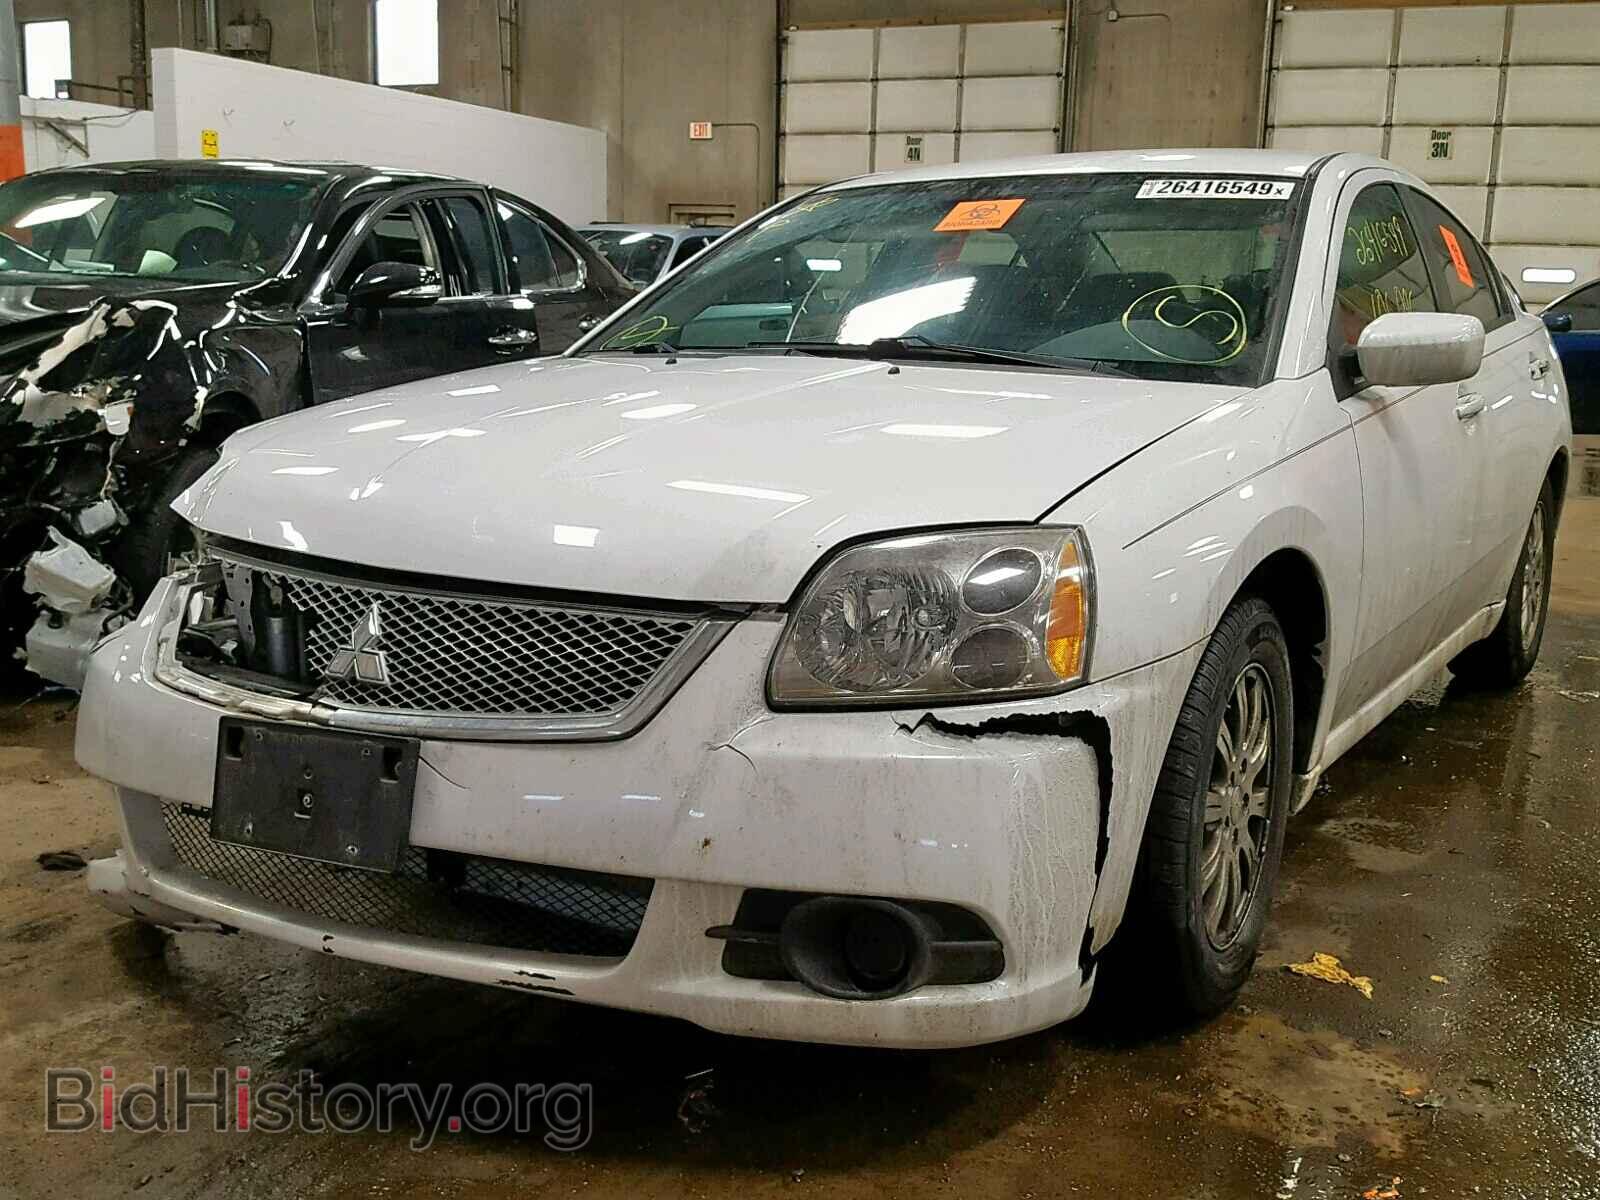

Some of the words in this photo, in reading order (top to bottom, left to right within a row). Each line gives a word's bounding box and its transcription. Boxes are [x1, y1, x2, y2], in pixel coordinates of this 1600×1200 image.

[694, 123, 709, 137] EXIT
[1431, 129, 1452, 140] Door
[906, 135, 922, 146] Door
[907, 147, 921, 161] 4N
[1431, 142, 1449, 158] 3N
